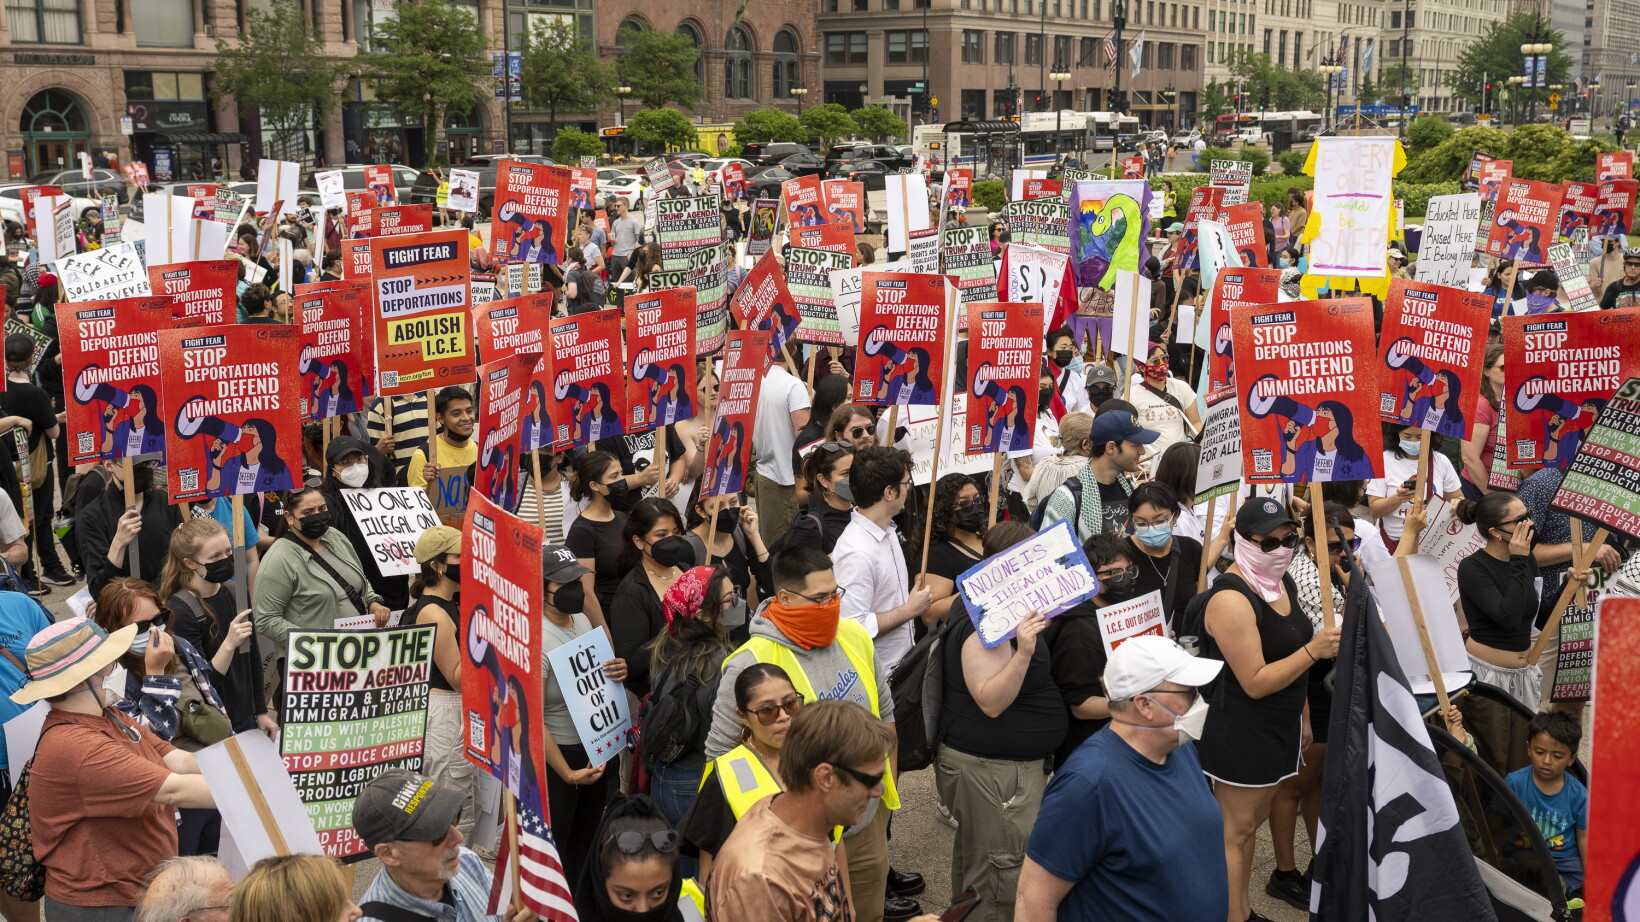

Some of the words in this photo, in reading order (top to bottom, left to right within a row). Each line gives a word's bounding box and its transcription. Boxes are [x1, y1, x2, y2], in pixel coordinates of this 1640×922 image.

[1212, 160, 1233, 169] STOP
[1236, 162, 1251, 170] THE
[1322, 144, 1394, 171] EVERY
[508, 173, 532, 185] STOP
[1336, 170, 1375, 191] ONE
[508, 184, 560, 197] DEPORTATIONS
[506, 202, 557, 216] IMMIGRANTS
[524, 195, 558, 207] DEFEND
[659, 200, 691, 213] STOP
[694, 197, 716, 210] THE
[659, 213, 684, 221] TRUMP
[687, 209, 718, 219] AGENDA!
[1340, 212, 1356, 228] be
[1463, 202, 1478, 220] HERE
[380, 216, 400, 227] STOP
[946, 229, 974, 246] STOP
[1455, 224, 1474, 242] HERE
[389, 248, 420, 264] FIGHT
[423, 246, 450, 260] FEAR
[911, 240, 937, 251] IMMIGRANT
[1318, 228, 1380, 265] SAFE
[792, 249, 827, 265] STOP
[831, 254, 850, 269] THE
[1422, 247, 1432, 260] I
[1434, 246, 1457, 268] Belong
[926, 262, 937, 272] ALL!
[67, 271, 135, 299] SOLIDARITY
[164, 278, 191, 294] STOP
[382, 278, 412, 295] STOP
[383, 291, 462, 313] DEPORTATIONS
[876, 290, 906, 304] STOP
[98, 309, 111, 317] FEAR
[185, 299, 222, 315] DEFEND
[876, 304, 940, 315] DEPORTATIONS
[1402, 298, 1437, 317] STOP
[638, 309, 662, 326] STOP
[896, 316, 938, 329] DEFEND
[1254, 316, 1273, 324] FIGHT
[1275, 314, 1291, 322] FEAR
[1401, 314, 1473, 338] DEPORTATIONS
[1527, 323, 1545, 331] FIGHT
[1547, 322, 1563, 330] FEAR
[78, 320, 116, 338] STOP
[394, 316, 461, 342] ABOLISH
[638, 318, 686, 337] DEPORTATIONS
[872, 330, 936, 342] IMMIGRANTS
[982, 322, 1006, 336] STOP
[1253, 325, 1297, 345] STOP
[80, 332, 157, 352] DEPORTATIONS
[185, 339, 204, 347] FIGHT
[206, 336, 222, 345] FEAR
[426, 337, 462, 356] I.C.E.
[656, 330, 687, 349] DEFEND
[981, 337, 1033, 349] DEPORTATIONS
[1424, 331, 1471, 354] DEFEND
[1525, 332, 1568, 350] STOP
[109, 345, 158, 366] DEFEND
[184, 347, 227, 368] STOP
[638, 344, 687, 366] IMMIGRANTS
[998, 350, 1032, 365] DEFEND
[1255, 340, 1353, 360] DEPORTATIONS
[1396, 341, 1469, 367] IMMIGRANTS
[1526, 346, 1620, 363] DEPORTATIONS
[82, 362, 159, 384] IMMIGRANTS
[185, 362, 279, 383] DEPORTATIONS
[979, 366, 1031, 380] IMMIGRANTS
[1289, 356, 1354, 377] DEFEND
[1558, 360, 1620, 378] DEFEND
[218, 377, 279, 398] DEFEND
[1257, 376, 1355, 397] IMMIGRANTS
[1526, 376, 1620, 395] IMMIGRANTS
[186, 395, 280, 418] IMMIGRANTS
[1205, 422, 1226, 440] RIGHTS
[1593, 424, 1625, 442] STAND
[1582, 443, 1610, 457] STOP
[1589, 434, 1608, 446] END
[1612, 440, 1625, 451] US
[1200, 447, 1217, 465] FOR
[1576, 454, 1615, 471] DEFEND
[1567, 470, 1597, 486] DEFEND
[346, 493, 373, 511] NO
[378, 490, 414, 510] ONE
[414, 490, 432, 511] IS
[1557, 488, 1596, 507] DEFEND
[1562, 480, 1617, 504] UNIONIZE
[1552, 497, 1611, 522] ACADEMIC
[361, 515, 416, 536] ILLEGAL
[416, 513, 436, 529] ON
[472, 529, 496, 567] STOP
[553, 549, 576, 562] NY
[968, 573, 993, 598] NO
[991, 557, 1020, 583] ONE
[1019, 544, 1047, 567] IS
[472, 558, 529, 614] DEPORTATIONS
[992, 575, 1036, 605] ILLEGAL
[1036, 565, 1053, 580] ON
[989, 584, 1049, 632] STOLEN
[1045, 570, 1085, 602] LAND
[493, 593, 529, 645] DEFEND
[1106, 621, 1124, 634] I.C.E.
[1125, 616, 1137, 628] OUT
[1137, 614, 1143, 624] OF
[1144, 607, 1160, 622] CHICAGO
[1562, 624, 1589, 634] STAND
[1562, 633, 1578, 641] END
[292, 635, 380, 670] STOP
[388, 630, 431, 665] THE
[475, 610, 530, 674] IMMIGRANTS
[1561, 641, 1584, 651] STOP
[569, 645, 600, 678] ICE
[1559, 651, 1593, 661] DEFEND
[289, 671, 358, 691] TRUMP
[362, 663, 428, 689] AGENDA!
[576, 667, 606, 696] OUT
[287, 694, 354, 708] DEFEND
[364, 692, 372, 704] &
[380, 684, 429, 702] EXPAND
[590, 689, 605, 707] OF
[286, 705, 378, 722] IMMIGRANT
[384, 697, 427, 716] RIGHTS
[590, 700, 620, 732] CHI
[286, 725, 332, 738] STAND
[339, 722, 368, 736] WITH
[372, 713, 423, 732] PALESTINE
[285, 739, 312, 752] END
[320, 738, 336, 750] US
[344, 735, 364, 749] AID
[370, 733, 383, 745] TO
[388, 726, 422, 742] ISRAEL
[283, 754, 322, 769] STOP
[330, 749, 376, 766] POLICE
[382, 740, 421, 758] CRIMES
[292, 772, 335, 787] EFEND
[400, 757, 421, 771] AND
